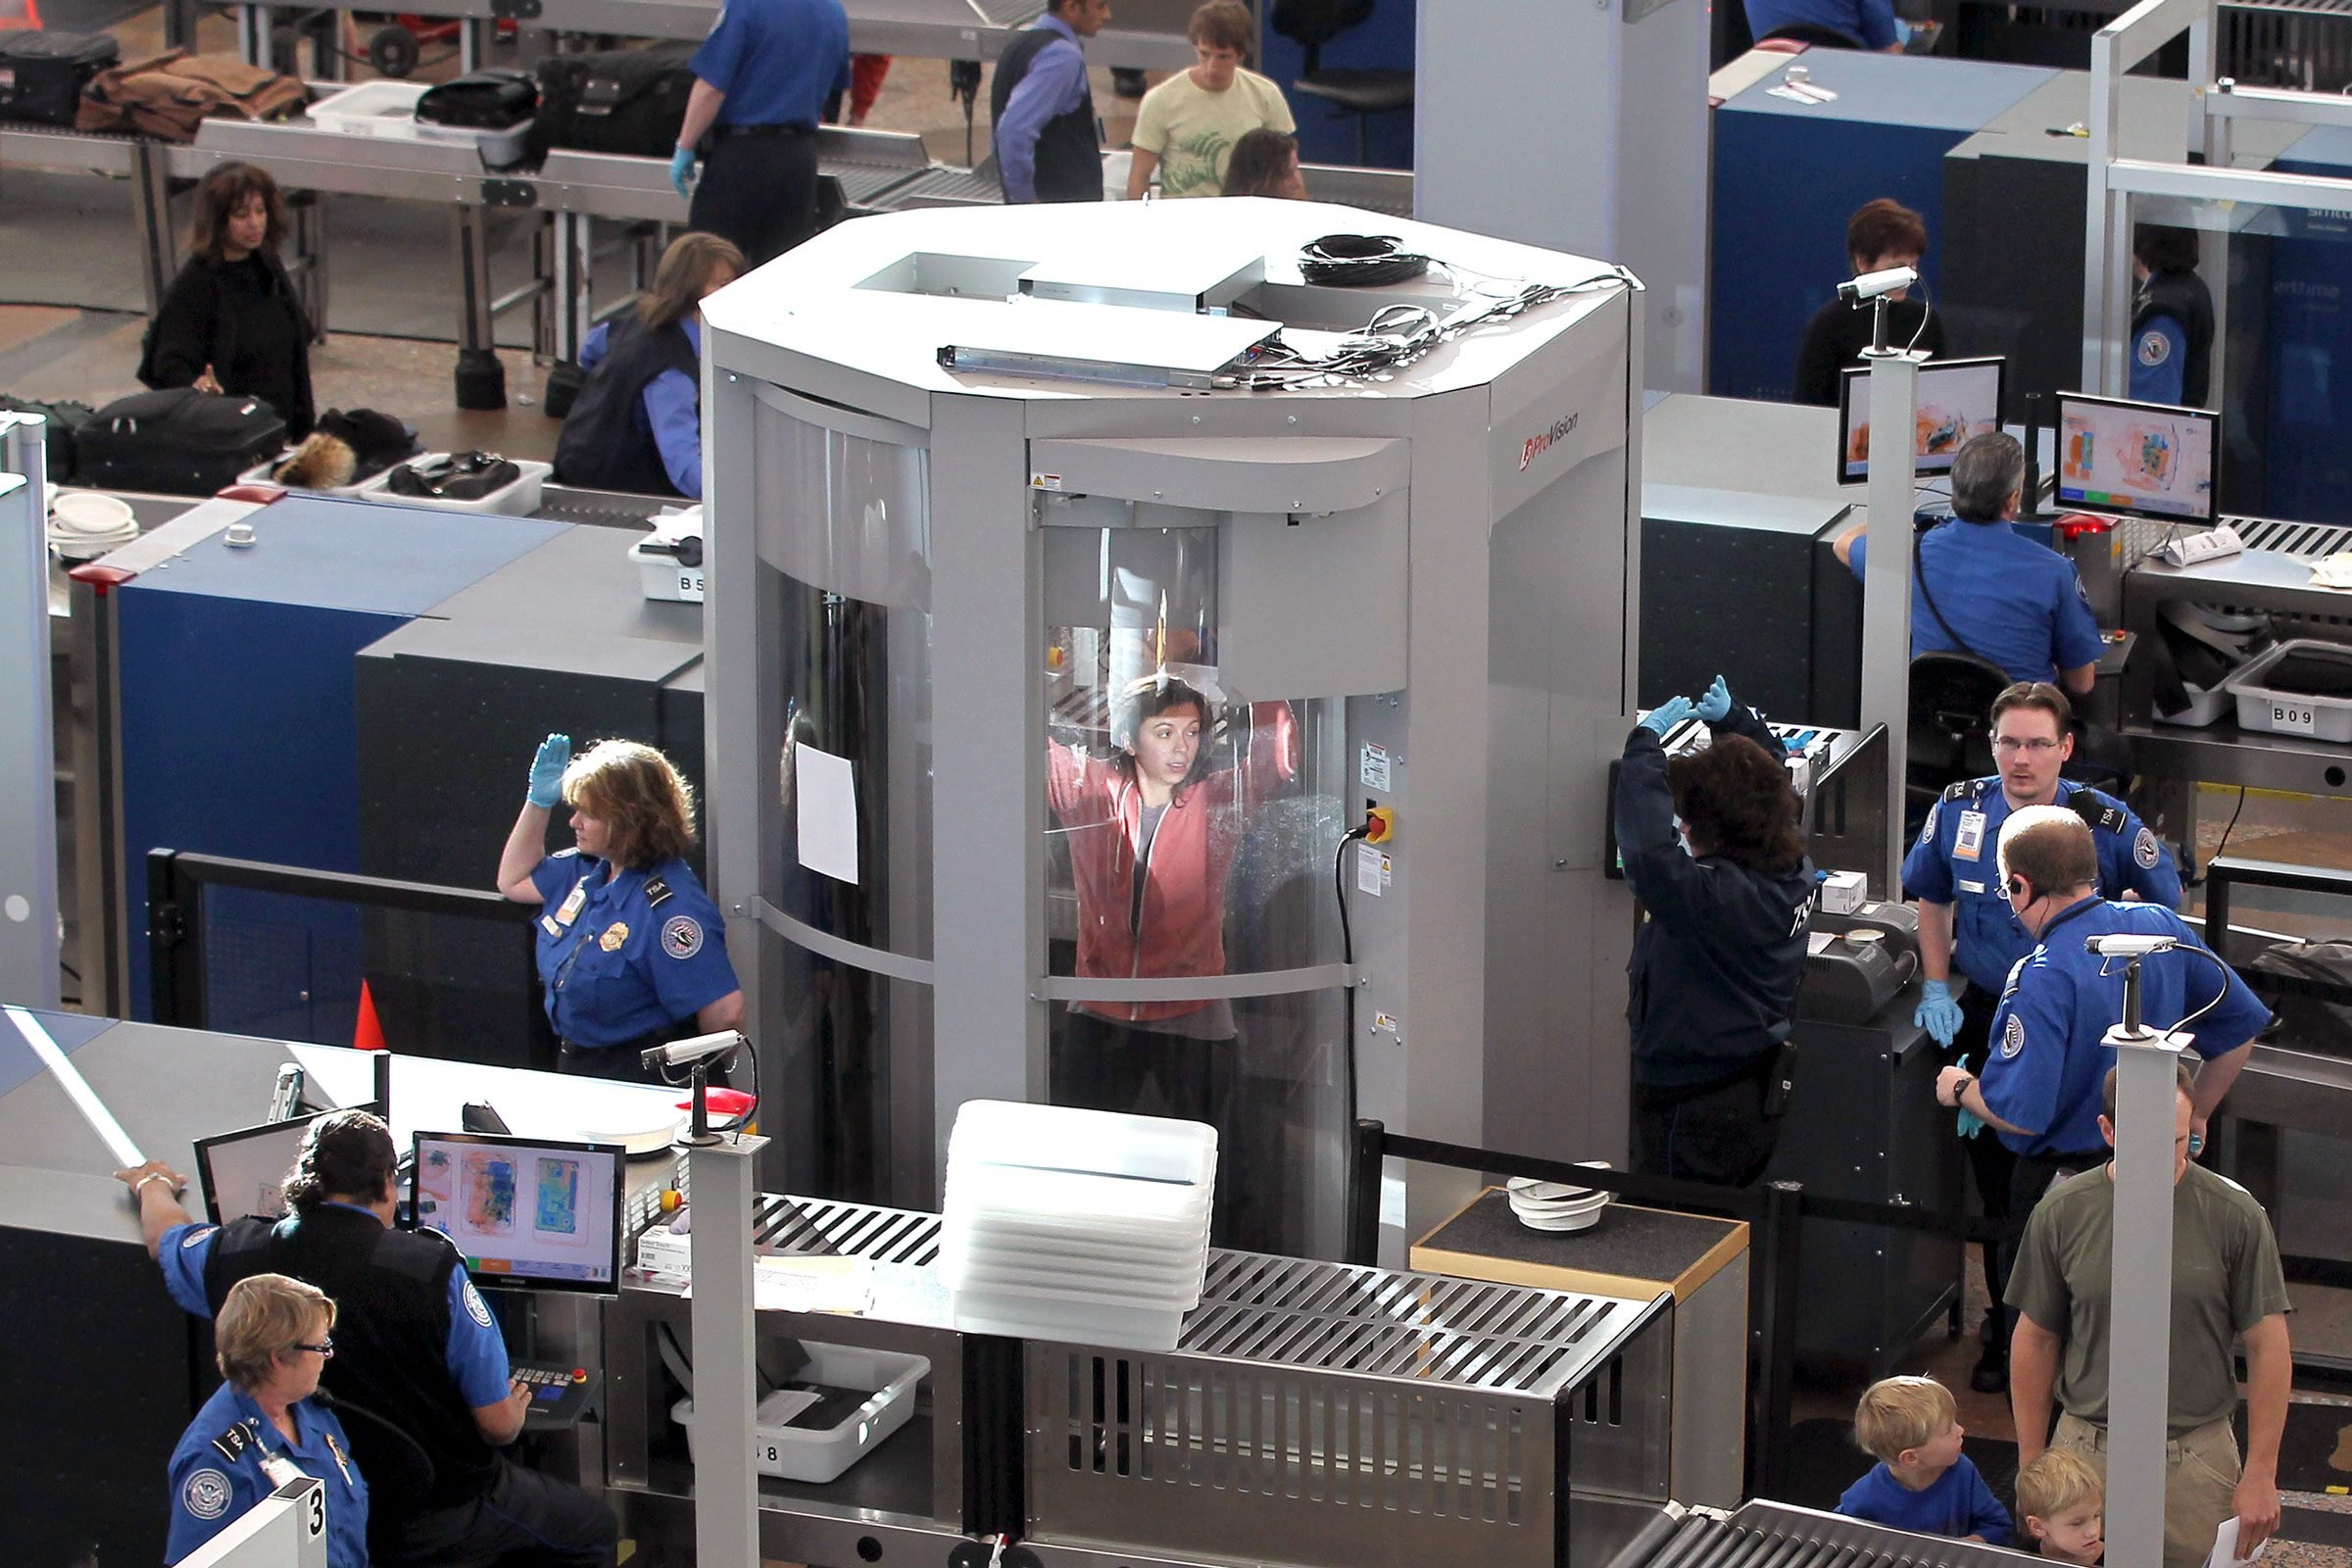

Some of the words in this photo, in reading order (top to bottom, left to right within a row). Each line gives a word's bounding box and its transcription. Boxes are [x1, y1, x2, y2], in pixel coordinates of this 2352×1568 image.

[2100, 808, 2115, 825] TSA
[647, 882, 666, 896] TSA
[226, 1428, 243, 1450] TSA
[309, 1487, 324, 1537] 3
